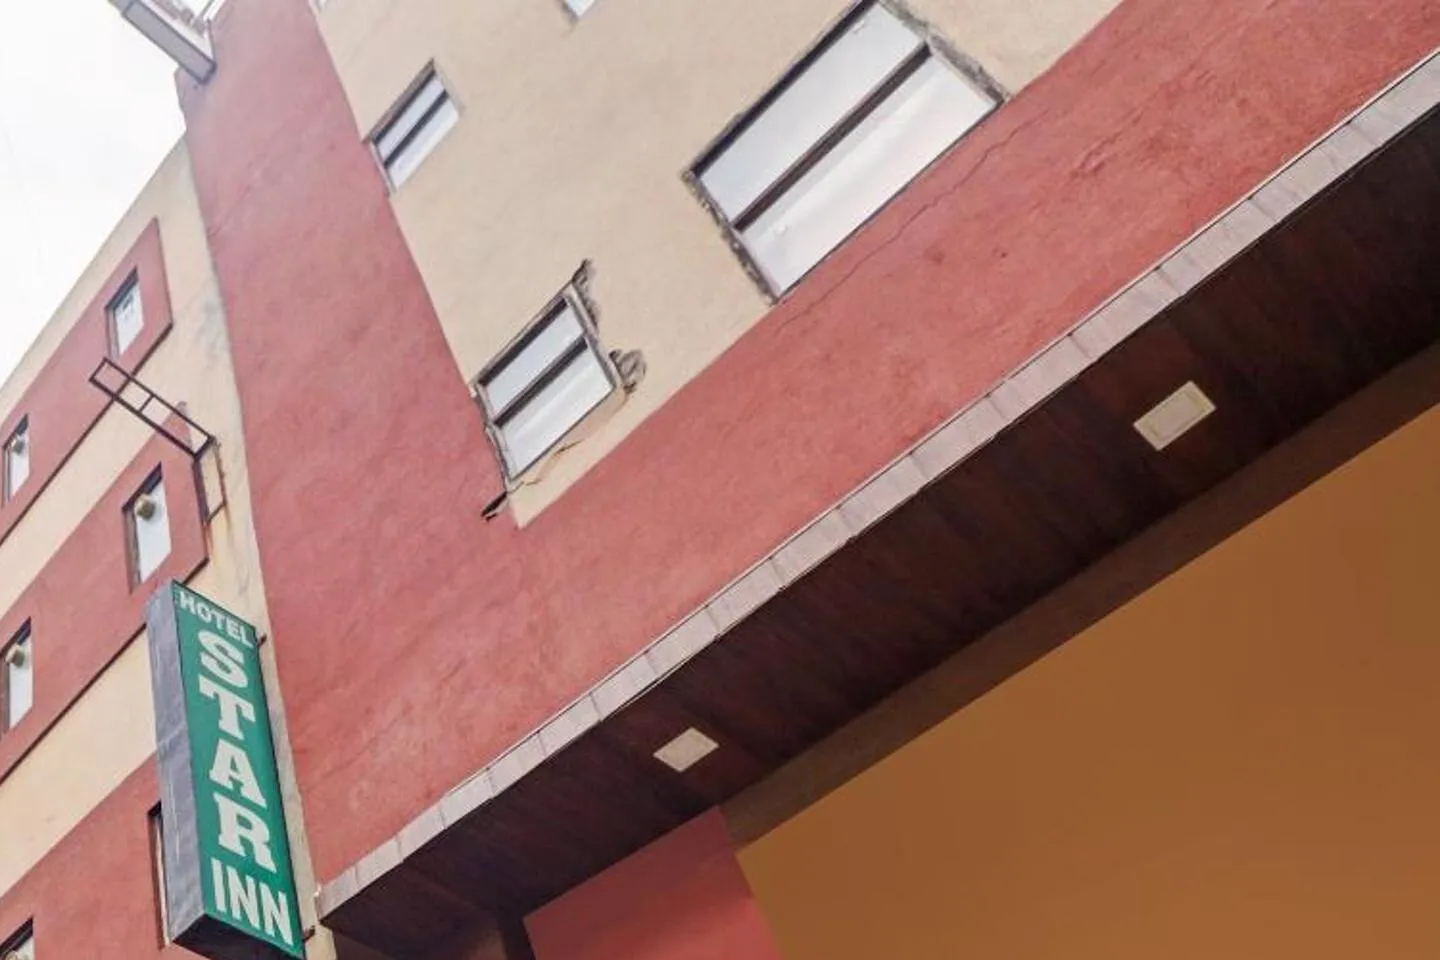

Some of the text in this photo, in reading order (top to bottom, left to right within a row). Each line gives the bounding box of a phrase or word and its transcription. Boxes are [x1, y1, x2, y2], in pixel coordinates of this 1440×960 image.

[180, 591, 254, 648] HOTEL
[198, 630, 277, 873] STAR
[211, 857, 293, 945] INN
